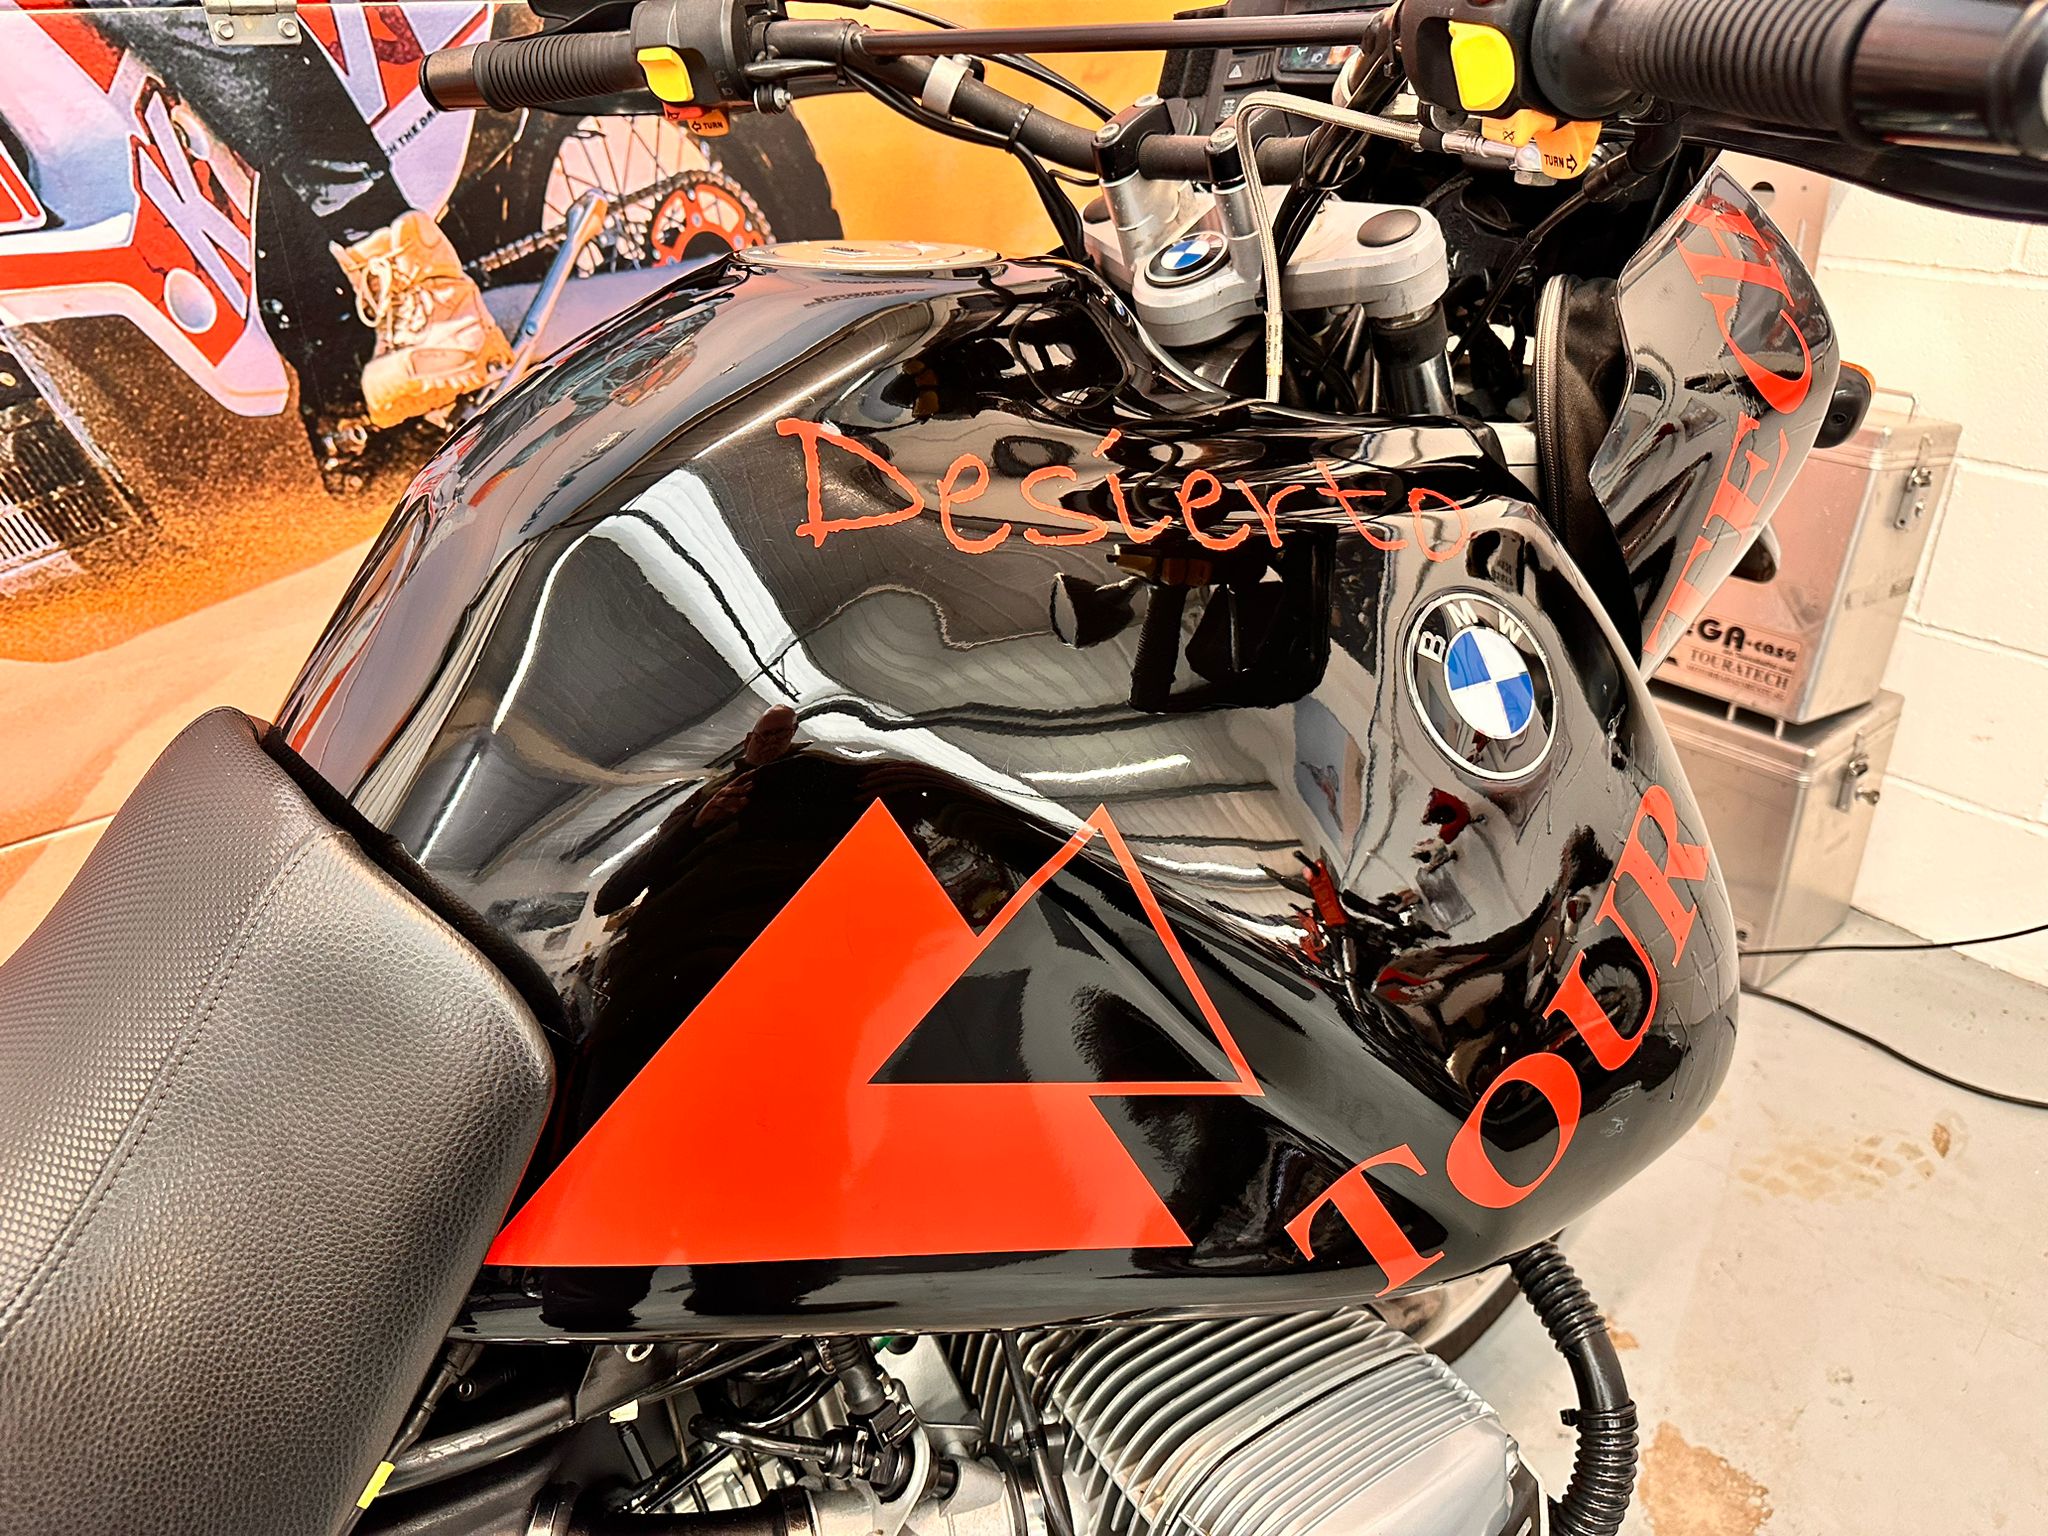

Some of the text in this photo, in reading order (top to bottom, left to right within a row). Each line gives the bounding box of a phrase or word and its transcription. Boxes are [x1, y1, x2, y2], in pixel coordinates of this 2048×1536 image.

[703, 121, 723, 130] TURN
[1544, 154, 1565, 168] TURN
[775, 417, 1474, 563] Desierto
[1417, 600, 1523, 664] BMW
[1686, 619, 1797, 662] GA-case
[1690, 649, 1789, 691] TOURATECH
[1285, 784, 1710, 1298] TOUR
